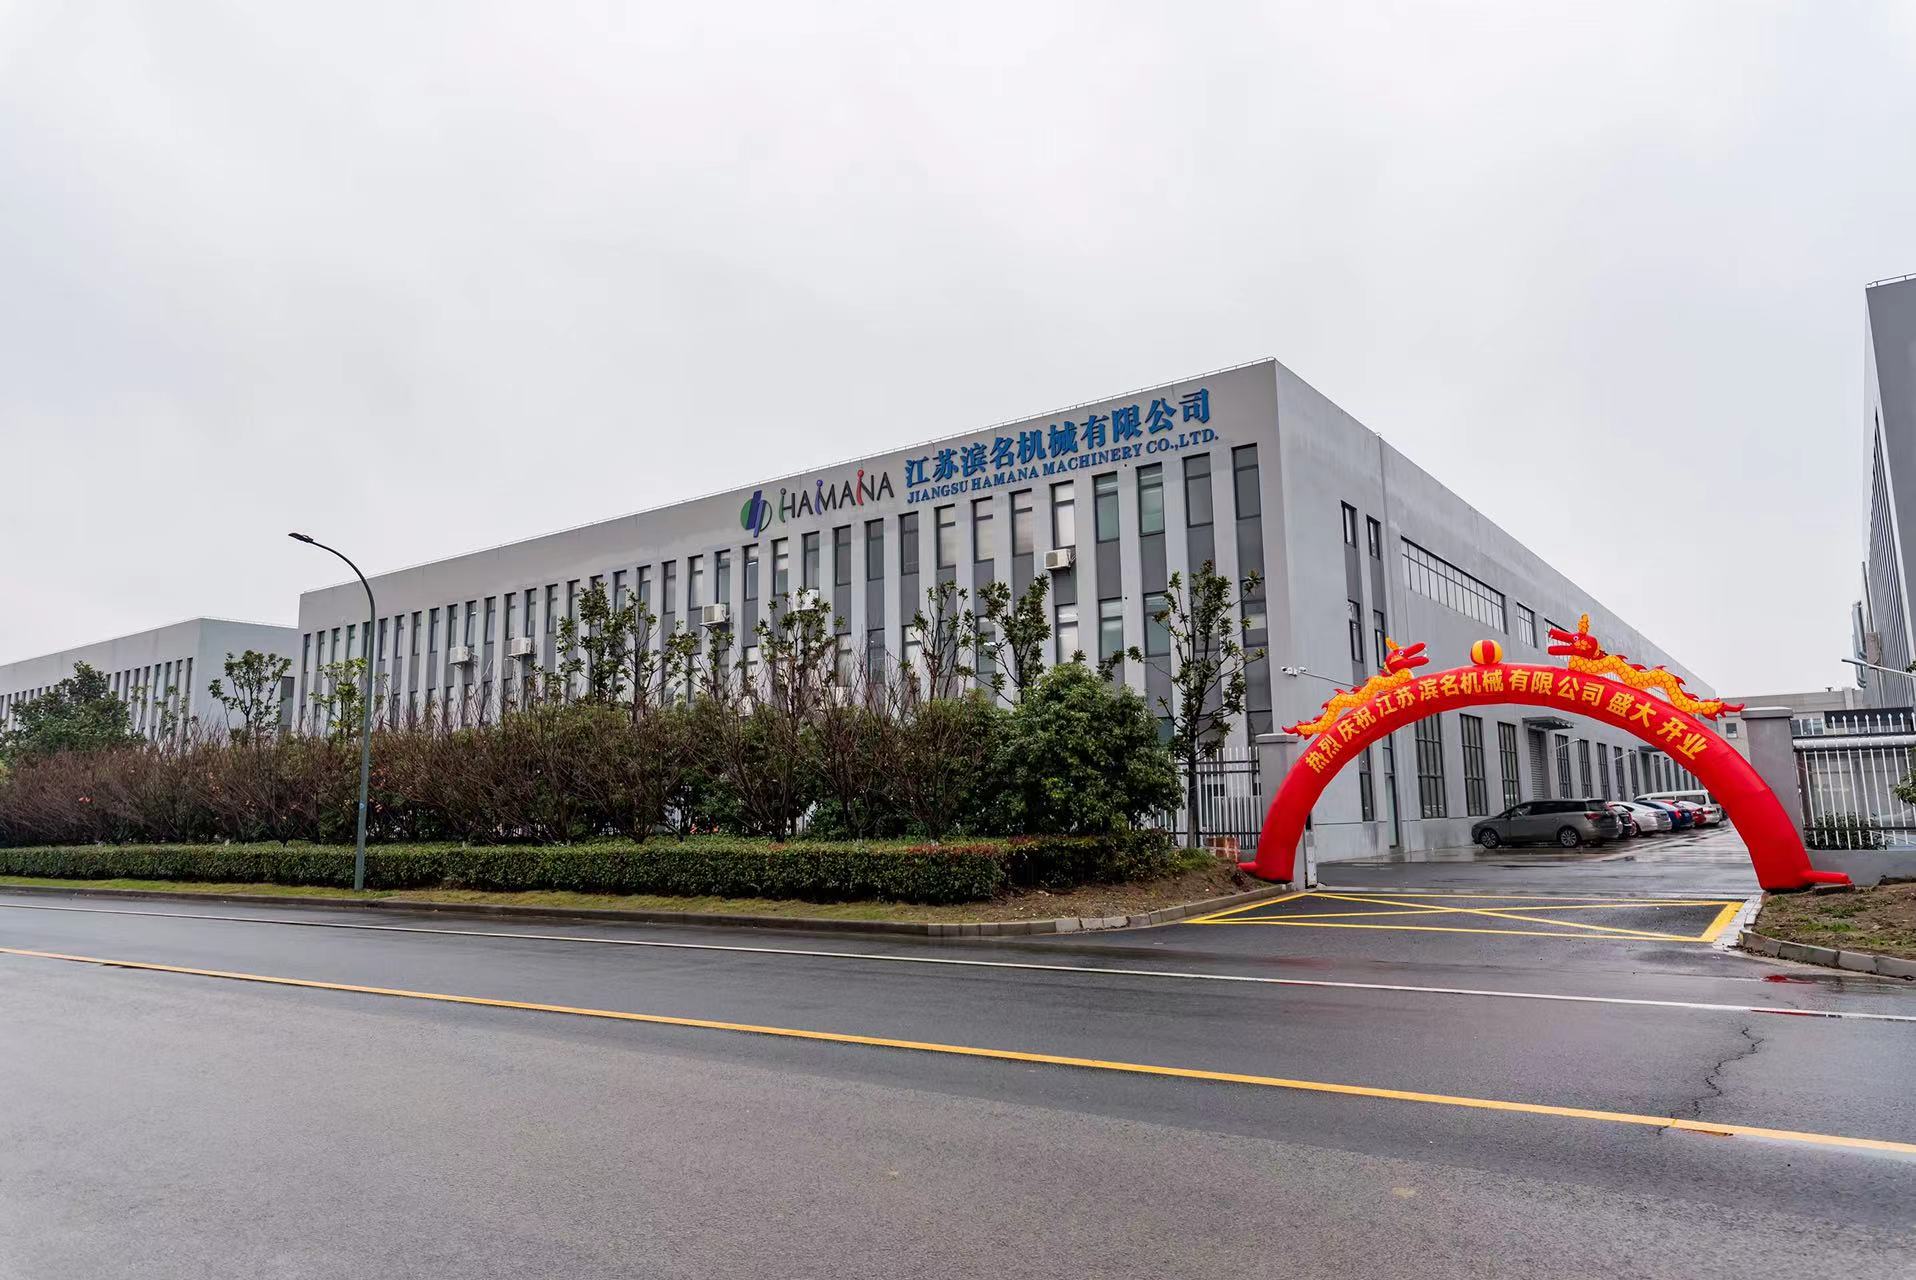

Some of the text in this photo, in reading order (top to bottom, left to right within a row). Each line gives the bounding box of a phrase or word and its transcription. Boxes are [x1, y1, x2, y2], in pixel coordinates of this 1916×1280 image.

[905, 388, 1210, 488] 江苏滨名机械有限公司
[907, 480, 969, 504] JIANGSU
[971, 466, 1039, 491] HAMANA
[1042, 442, 1143, 476] MACHINERY
